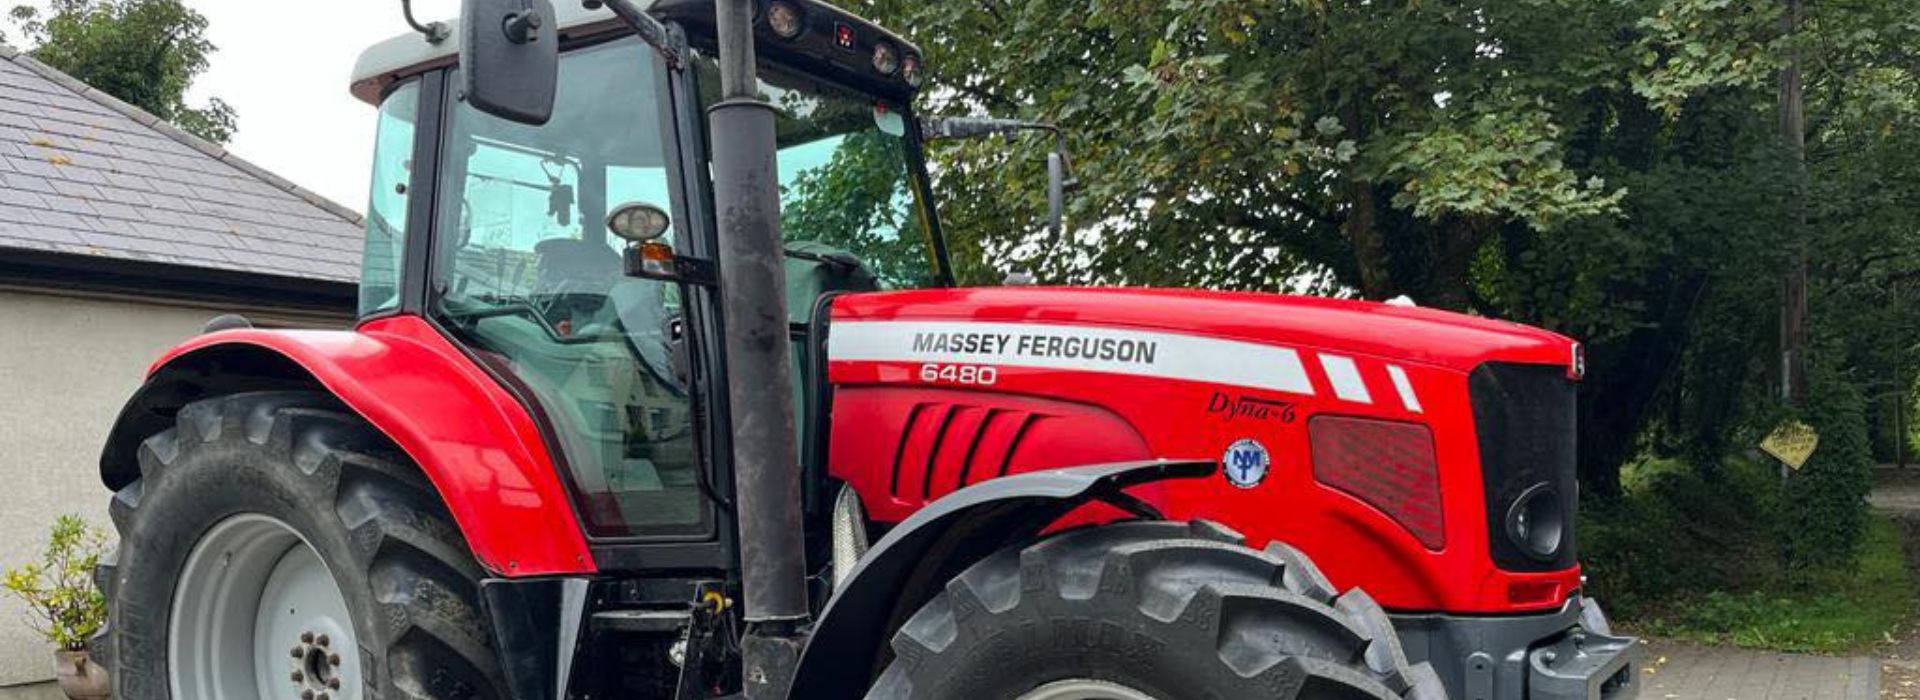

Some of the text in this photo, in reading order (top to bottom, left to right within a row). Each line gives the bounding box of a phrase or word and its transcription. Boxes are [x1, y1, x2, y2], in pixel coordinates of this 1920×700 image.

[912, 333, 1156, 364] MASSEY FERGUSON
[920, 363, 997, 385] 6480
[1207, 391, 1295, 424] Dyna-6
